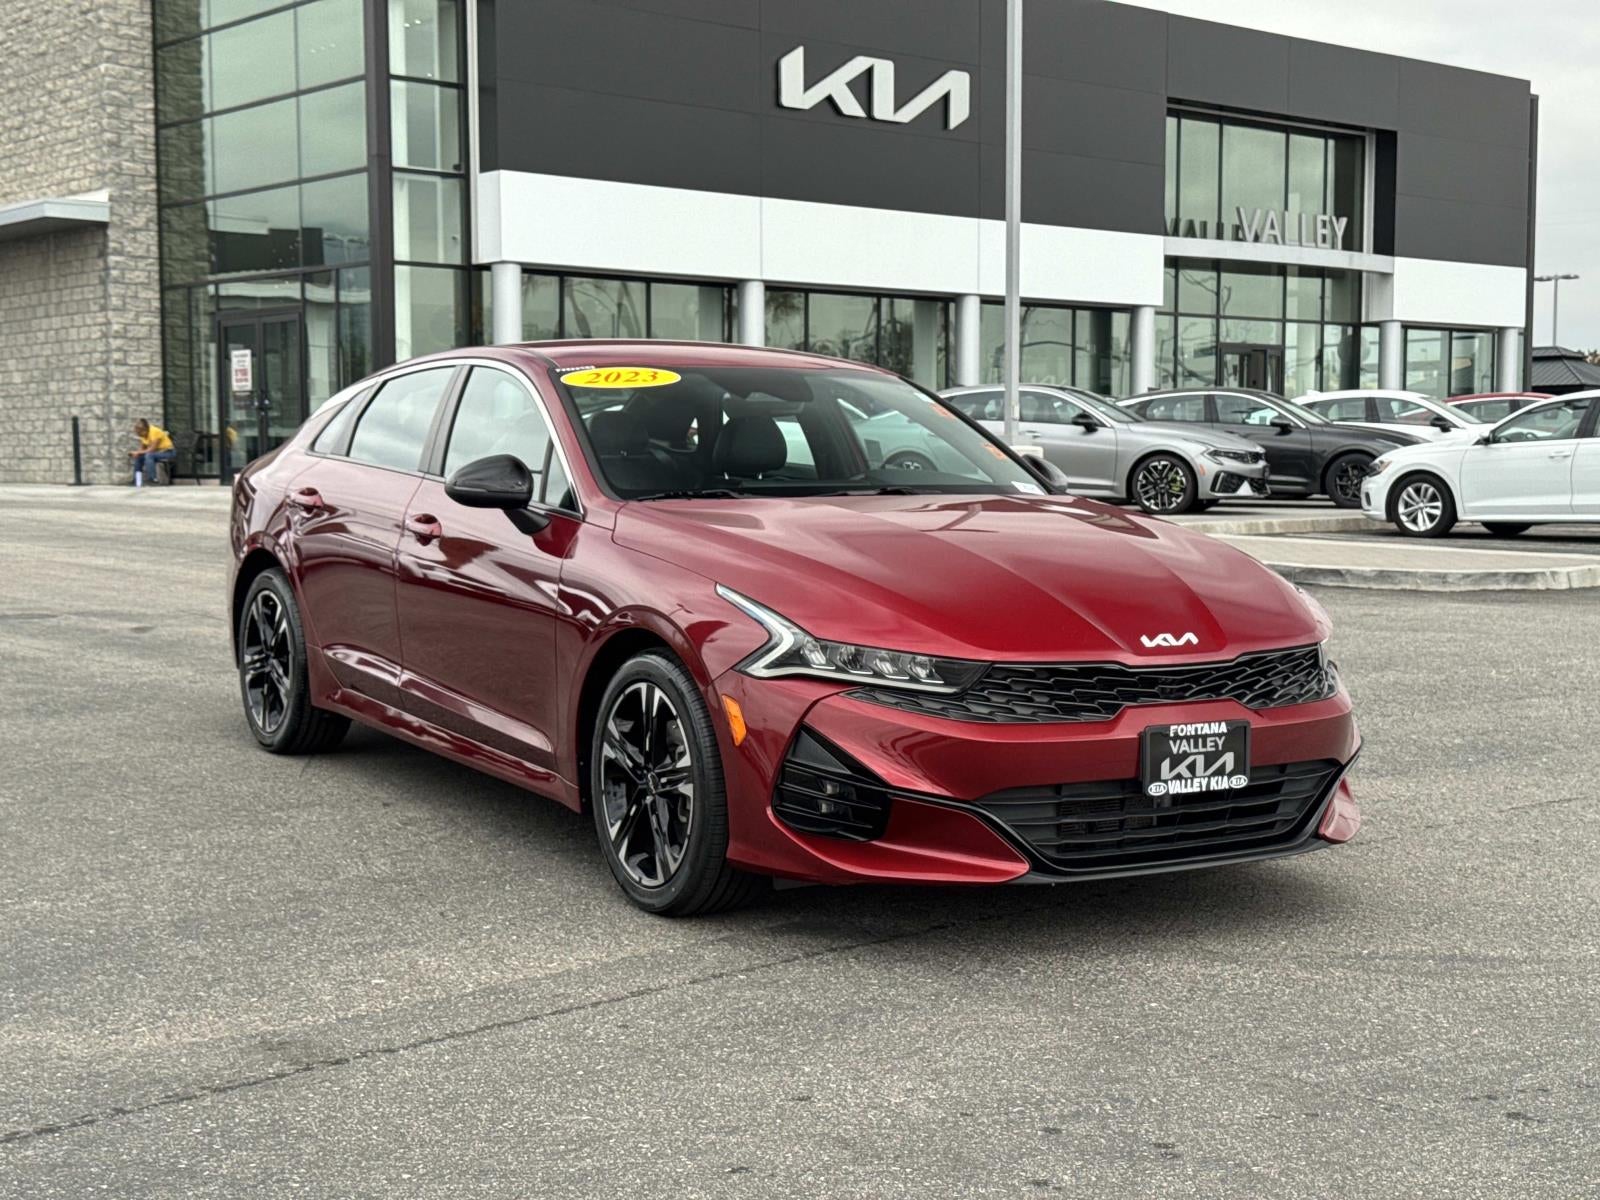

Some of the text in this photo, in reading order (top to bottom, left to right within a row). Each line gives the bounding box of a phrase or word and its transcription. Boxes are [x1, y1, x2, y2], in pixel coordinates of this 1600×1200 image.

[780, 45, 970, 130] KIA
[1238, 207, 1348, 250] VALLEY
[584, 371, 659, 384] 2023
[1140, 632, 1199, 647] KIA
[1169, 722, 1228, 737] FONTANA
[1169, 736, 1226, 754] VALLEY
[1160, 752, 1235, 780] KIA
[1168, 775, 1229, 794] VALLEY KIA
